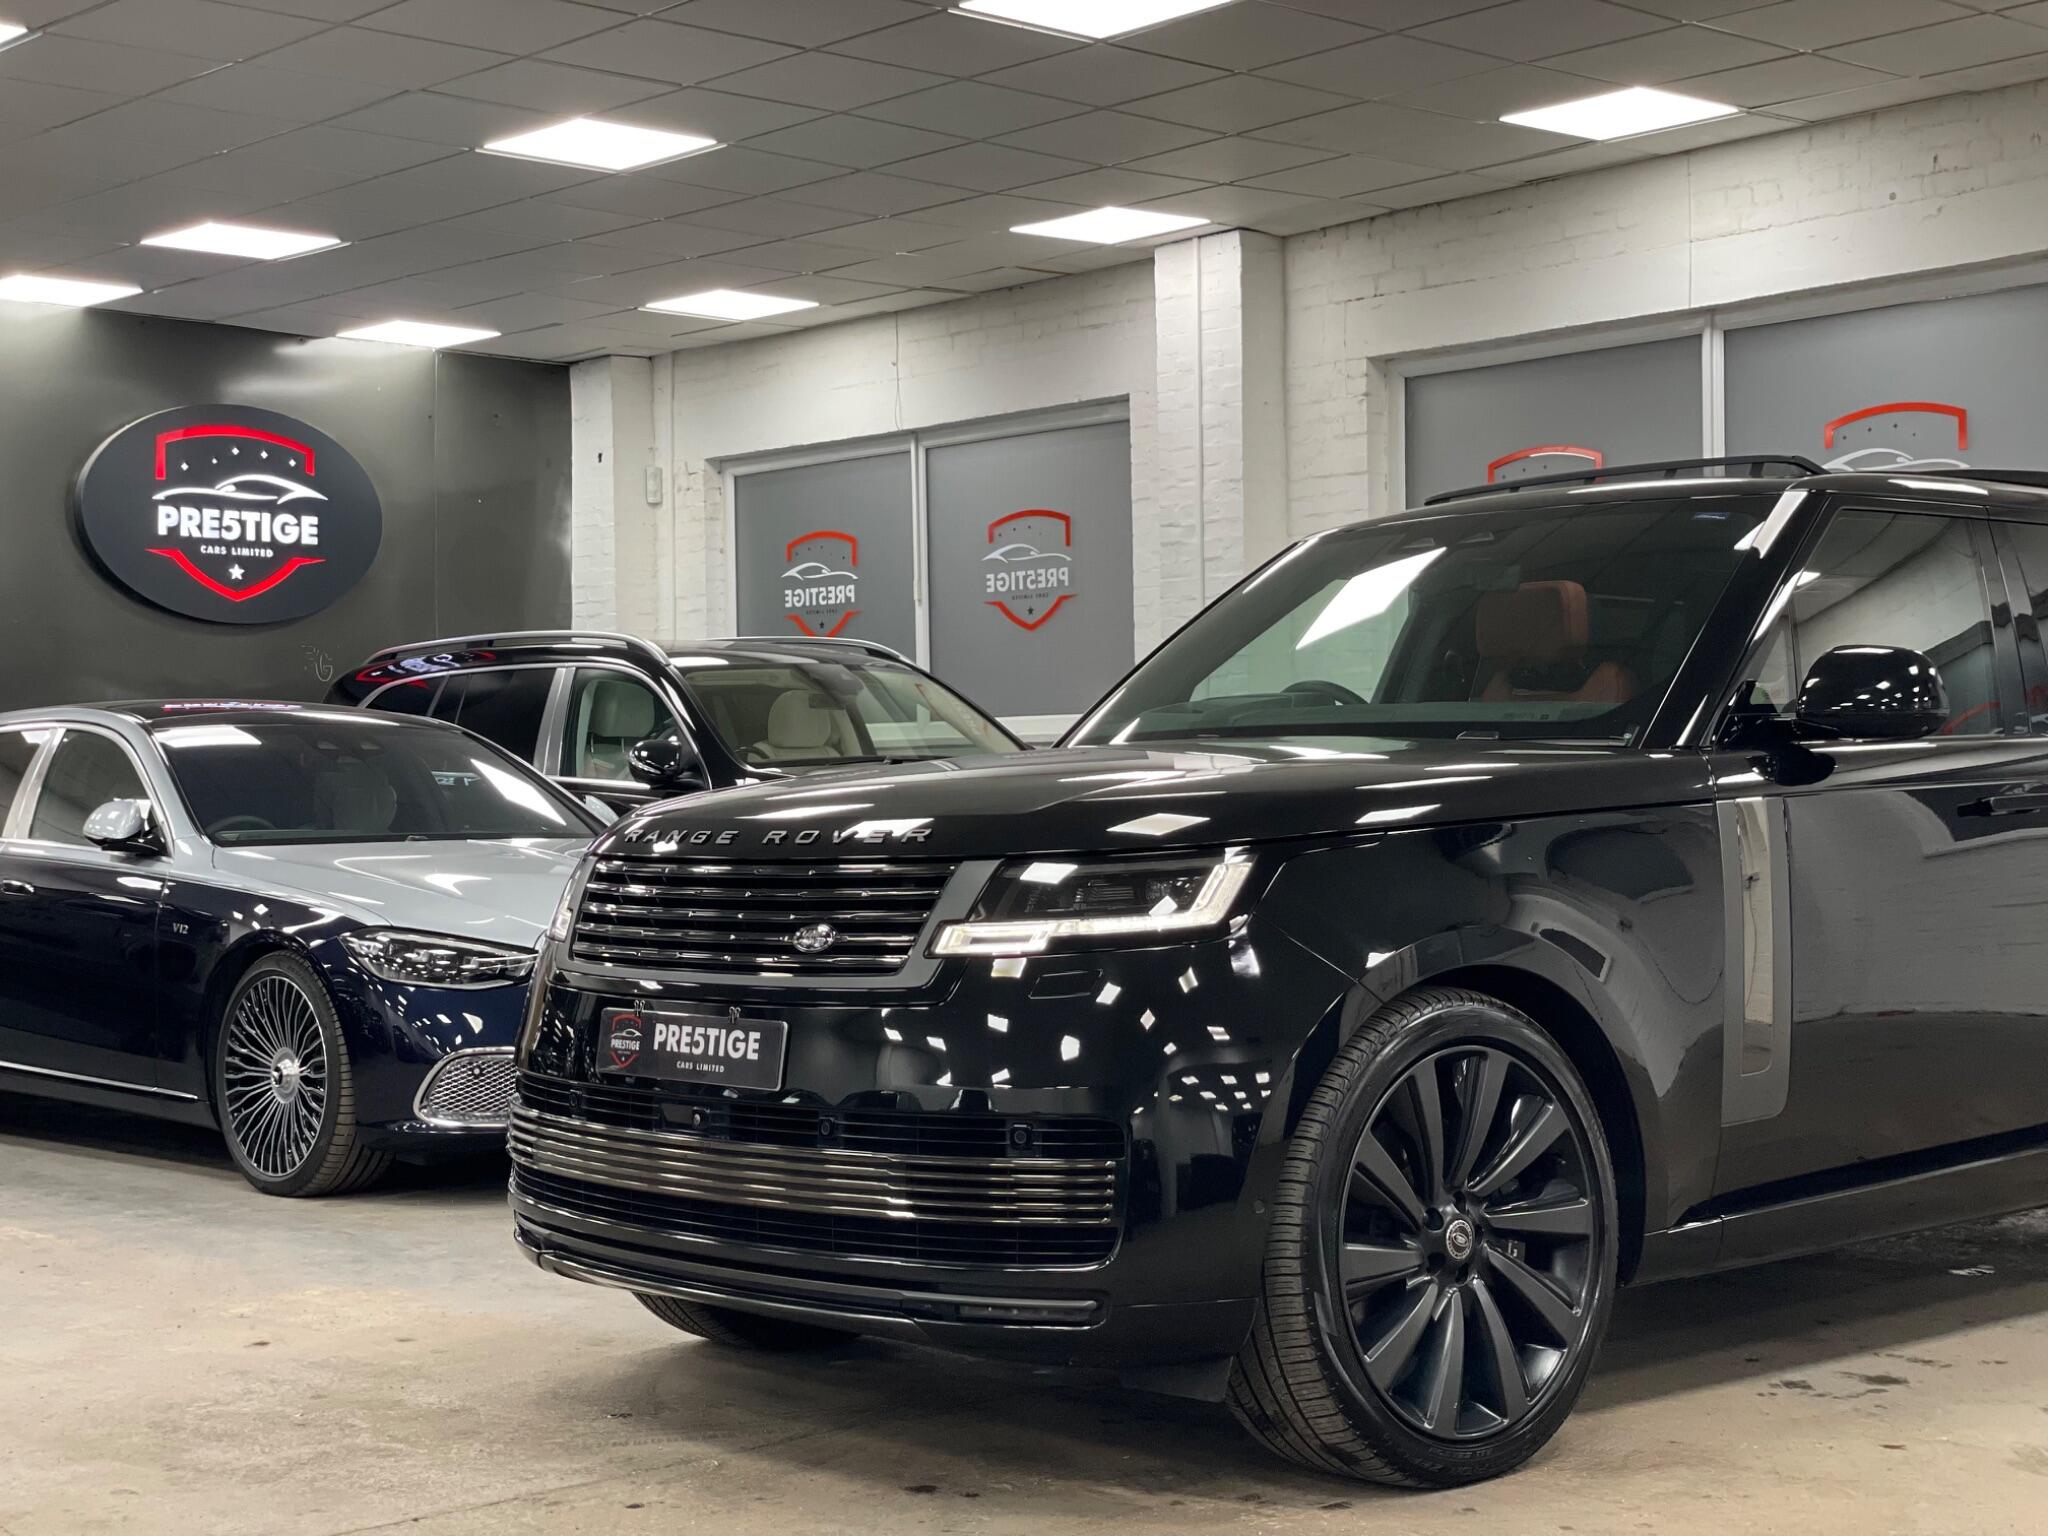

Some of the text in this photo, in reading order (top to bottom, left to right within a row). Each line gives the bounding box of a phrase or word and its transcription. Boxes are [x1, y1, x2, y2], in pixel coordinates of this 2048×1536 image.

[200, 545, 275, 558] CARS LIMITED
[624, 828, 933, 845] RANGE ROVER
[173, 922, 189, 934] V12
[676, 1061, 725, 1073] CARS LIMITED
